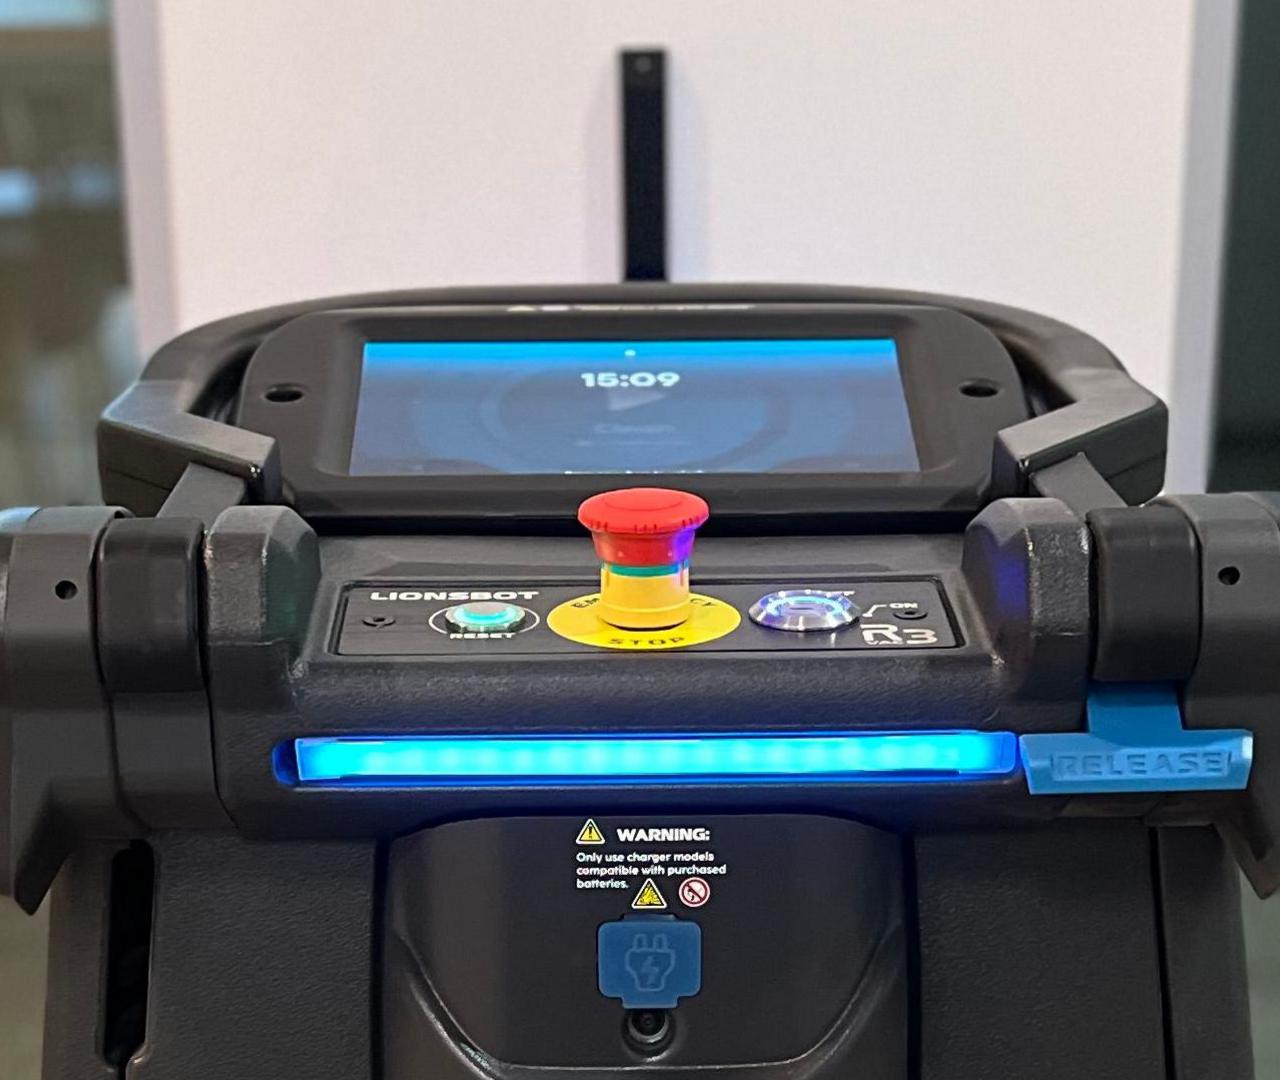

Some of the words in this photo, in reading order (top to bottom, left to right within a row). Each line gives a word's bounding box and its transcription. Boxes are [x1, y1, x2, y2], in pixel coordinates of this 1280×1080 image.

[581, 371, 680, 387] 15:09
[370, 591, 539, 600] LIONSBOT
[860, 624, 938, 644] R3
[610, 637, 684, 645] STOP
[1057, 752, 1223, 776] RELEASE
[617, 828, 711, 842] WARNING:
[576, 853, 603, 863] Only
[605, 854, 624, 862] use
[627, 852, 670, 863] charger
[673, 852, 715, 861] models
[576, 865, 639, 876] compatible
[641, 866, 665, 875] with
[667, 864, 726, 876] purchased
[576, 879, 629, 888] batteries.
